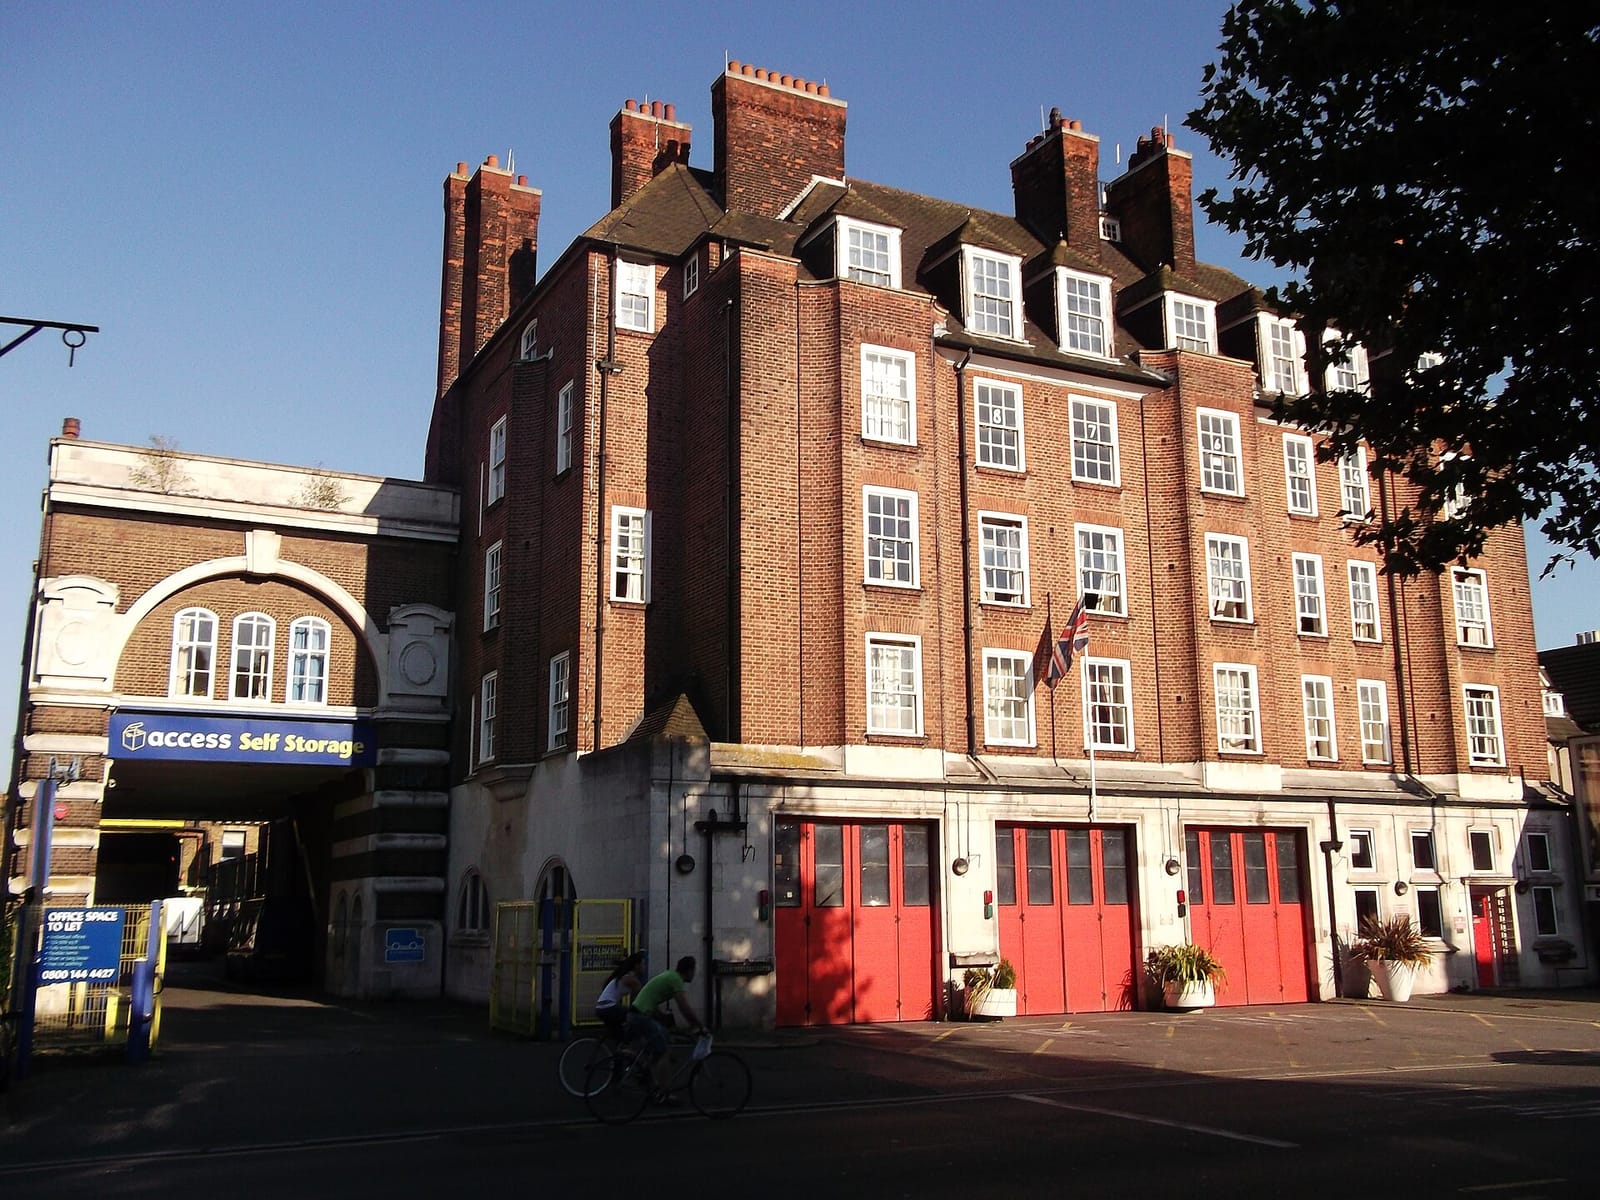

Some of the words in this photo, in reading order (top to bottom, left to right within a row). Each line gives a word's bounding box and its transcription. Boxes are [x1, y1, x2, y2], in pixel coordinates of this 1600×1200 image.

[993, 408, 1001, 424] 8
[1087, 424, 1096, 438] 7
[1213, 438, 1222, 450] 6
[1299, 462, 1307, 473] 5
[148, 731, 232, 750] access
[239, 732, 280, 752] Self
[284, 734, 364, 759] Storage
[48, 912, 84, 922] OFFICE
[85, 912, 118, 922] SPACE
[47, 922, 63, 932] TO
[64, 922, 83, 932] LET
[42, 969, 69, 980] 0800
[70, 969, 88, 979] 144
